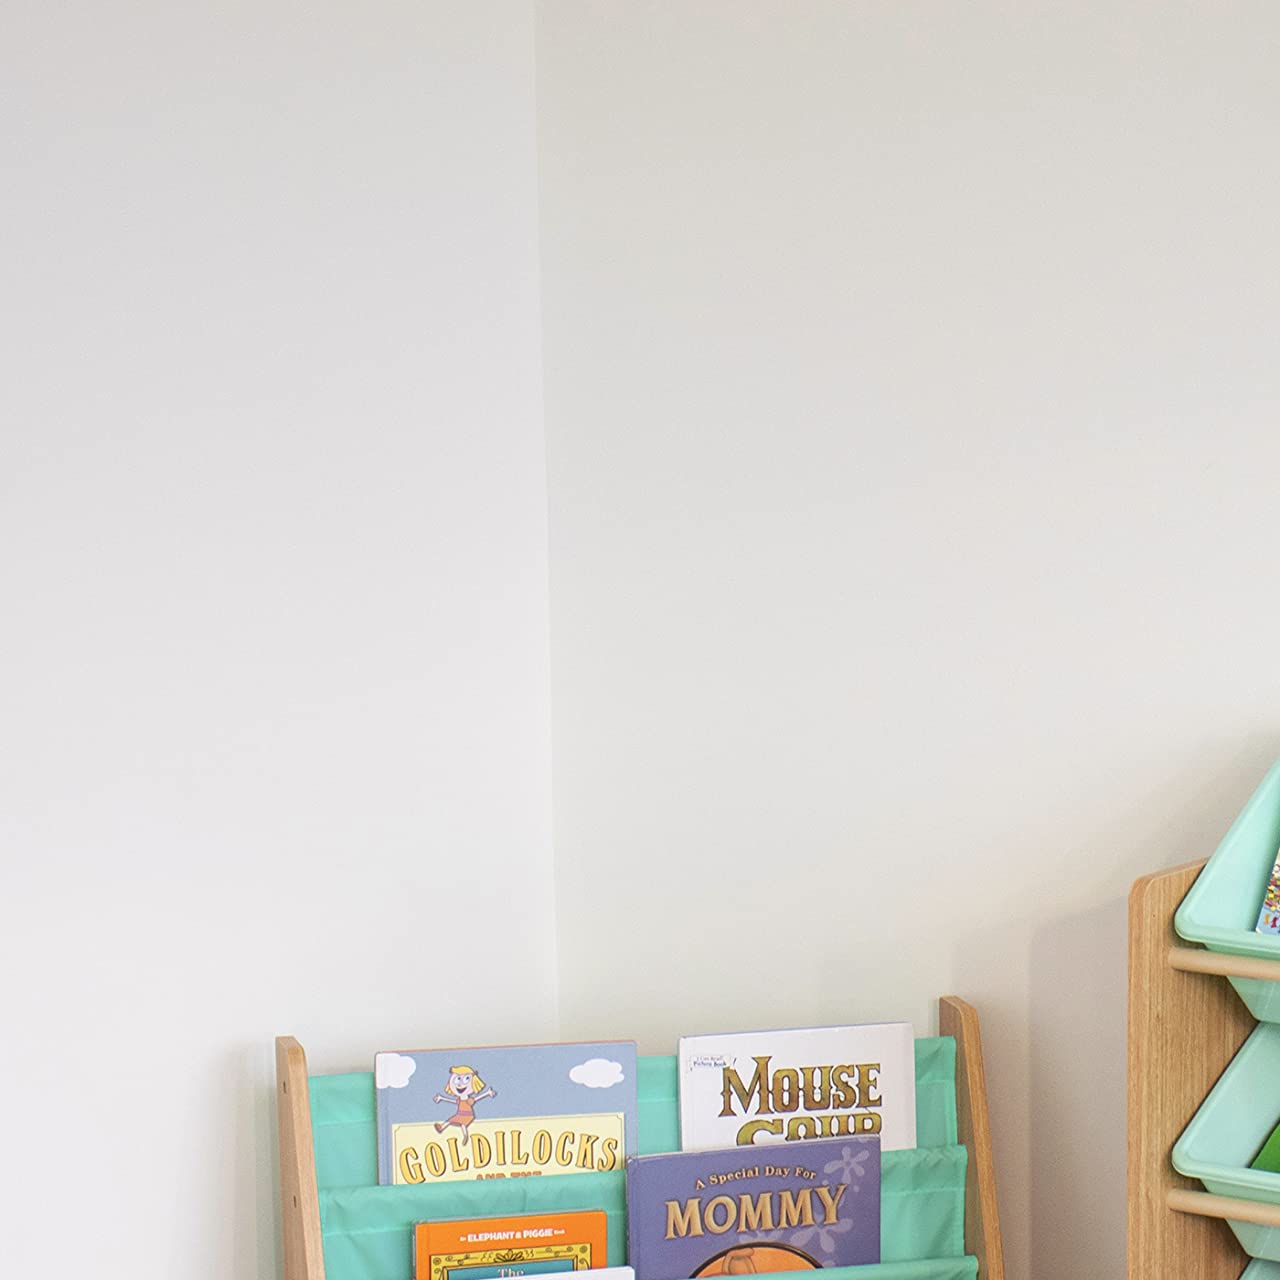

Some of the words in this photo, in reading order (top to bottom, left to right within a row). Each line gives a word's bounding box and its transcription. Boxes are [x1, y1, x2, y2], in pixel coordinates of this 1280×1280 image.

[718, 1055, 882, 1118] MOUSE
[399, 1130, 618, 1184] GOLDILOCKS
[695, 1179, 706, 1191] A
[708, 1166, 759, 1185] Special
[765, 1165, 791, 1178] Day
[795, 1166, 817, 1180] For
[467, 1231, 515, 1243] ELEPHANT
[523, 1228, 553, 1239] PIGGIE
[664, 1183, 849, 1241] MOMMY
